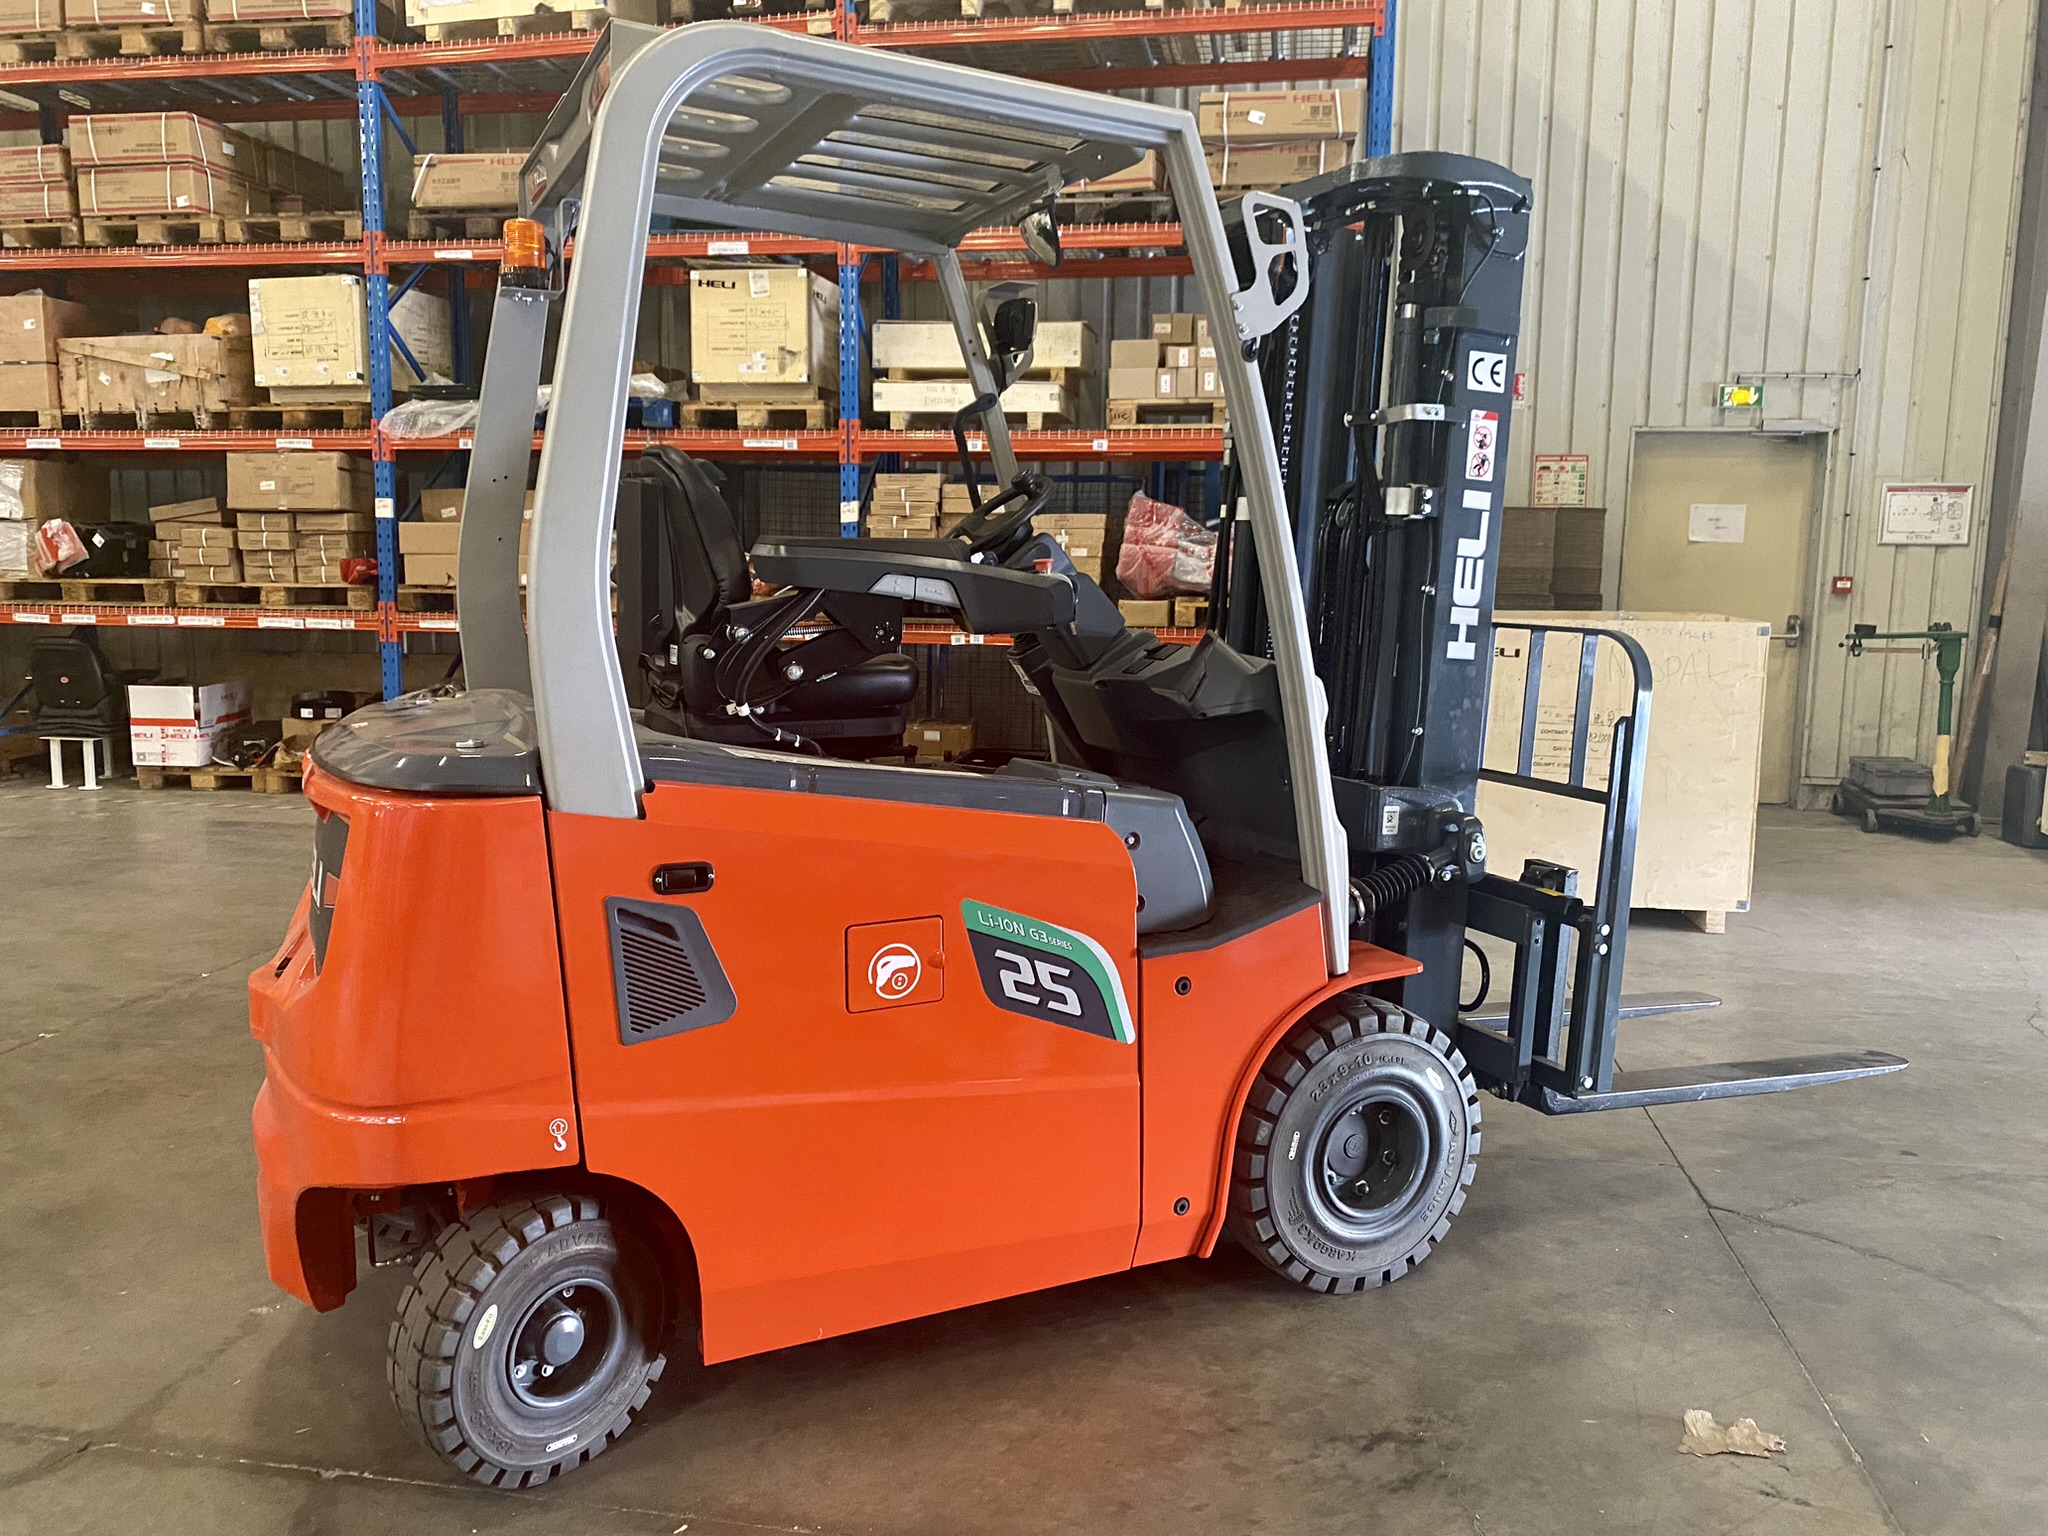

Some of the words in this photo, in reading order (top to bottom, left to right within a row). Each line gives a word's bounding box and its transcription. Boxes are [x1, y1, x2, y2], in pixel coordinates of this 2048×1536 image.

[698, 279, 736, 290] HELI
[812, 289, 827, 304] HELI
[1471, 357, 1504, 388] CE
[1446, 489, 1492, 660] HELI
[978, 910, 1026, 937] Li-ION
[1029, 928, 1049, 943] G3
[1048, 936, 1073, 951] SERIES
[994, 948, 1083, 1017] 25
[1420, 1140, 1458, 1223] ADVANCE
[546, 1230, 606, 1258] ADVAN
